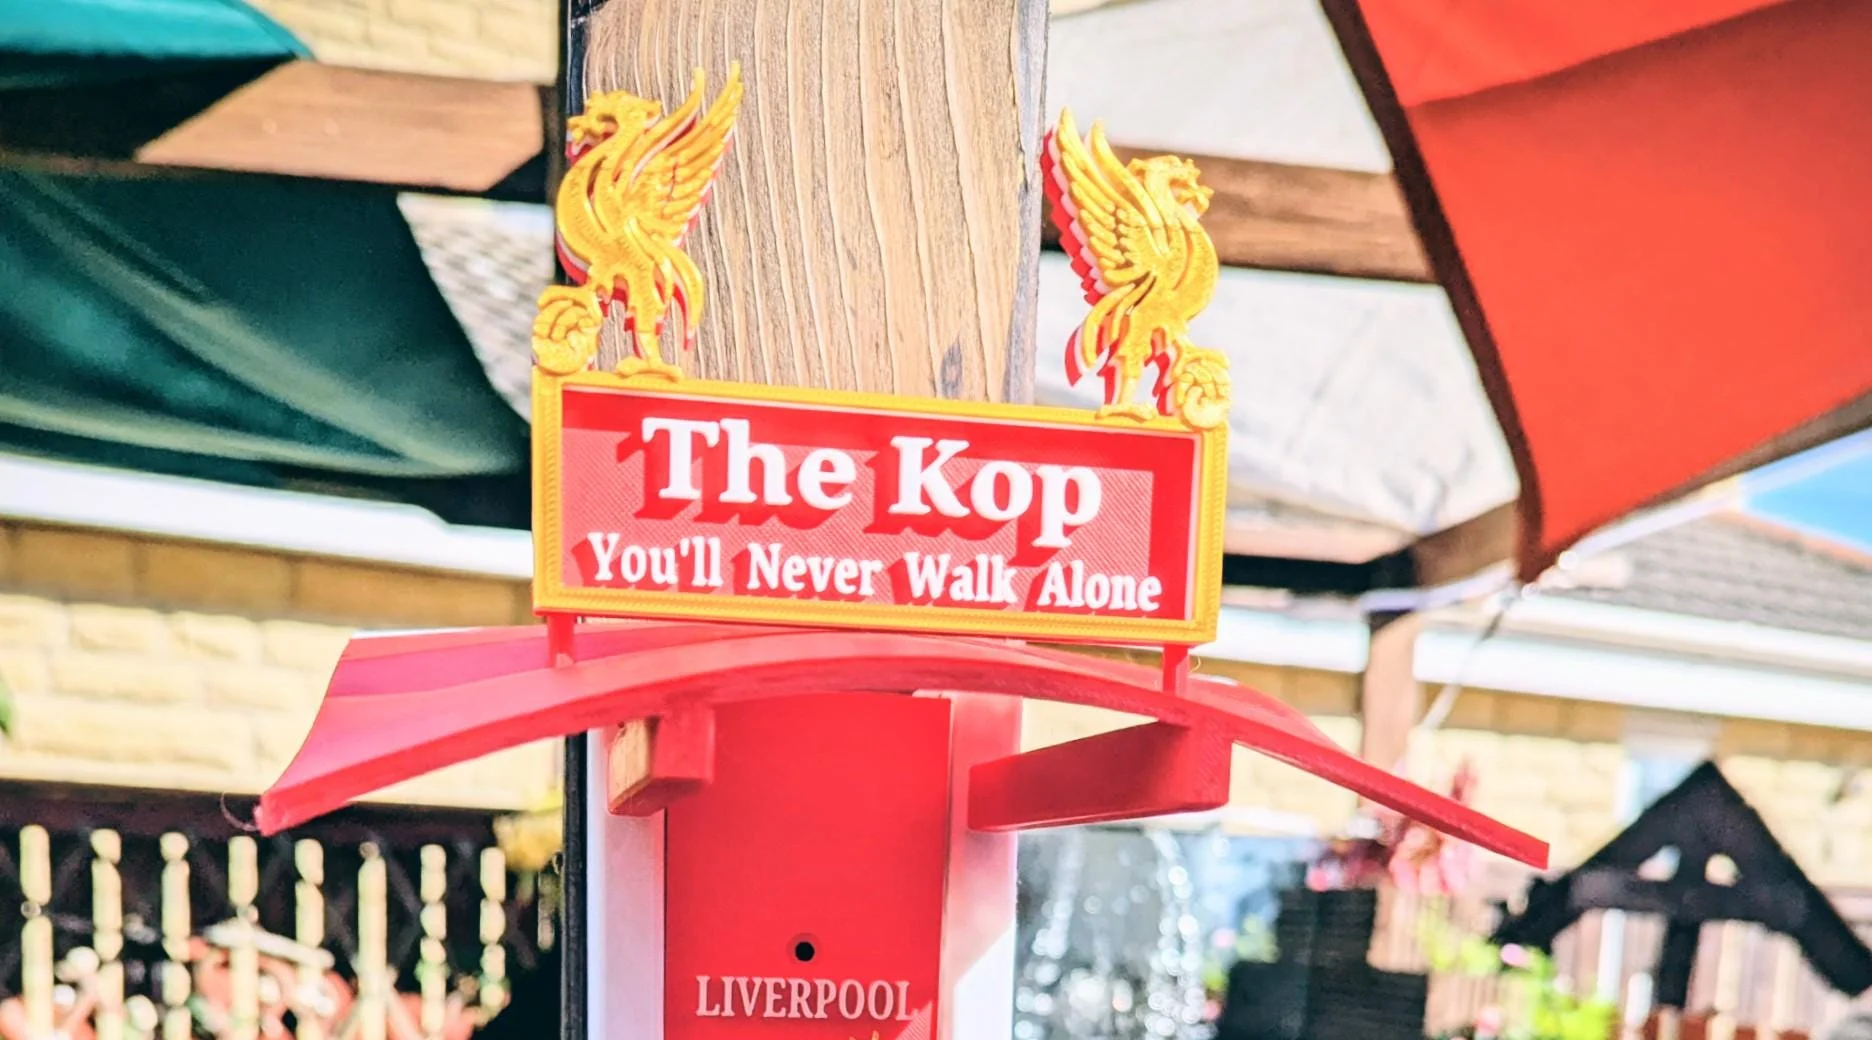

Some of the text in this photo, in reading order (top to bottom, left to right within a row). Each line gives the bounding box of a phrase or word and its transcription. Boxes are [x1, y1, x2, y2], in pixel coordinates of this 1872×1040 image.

[642, 417, 1102, 548] The Kop
[587, 532, 1162, 612] You'll Never Walk Alone
[695, 975, 919, 1021] LIVERPOOL
